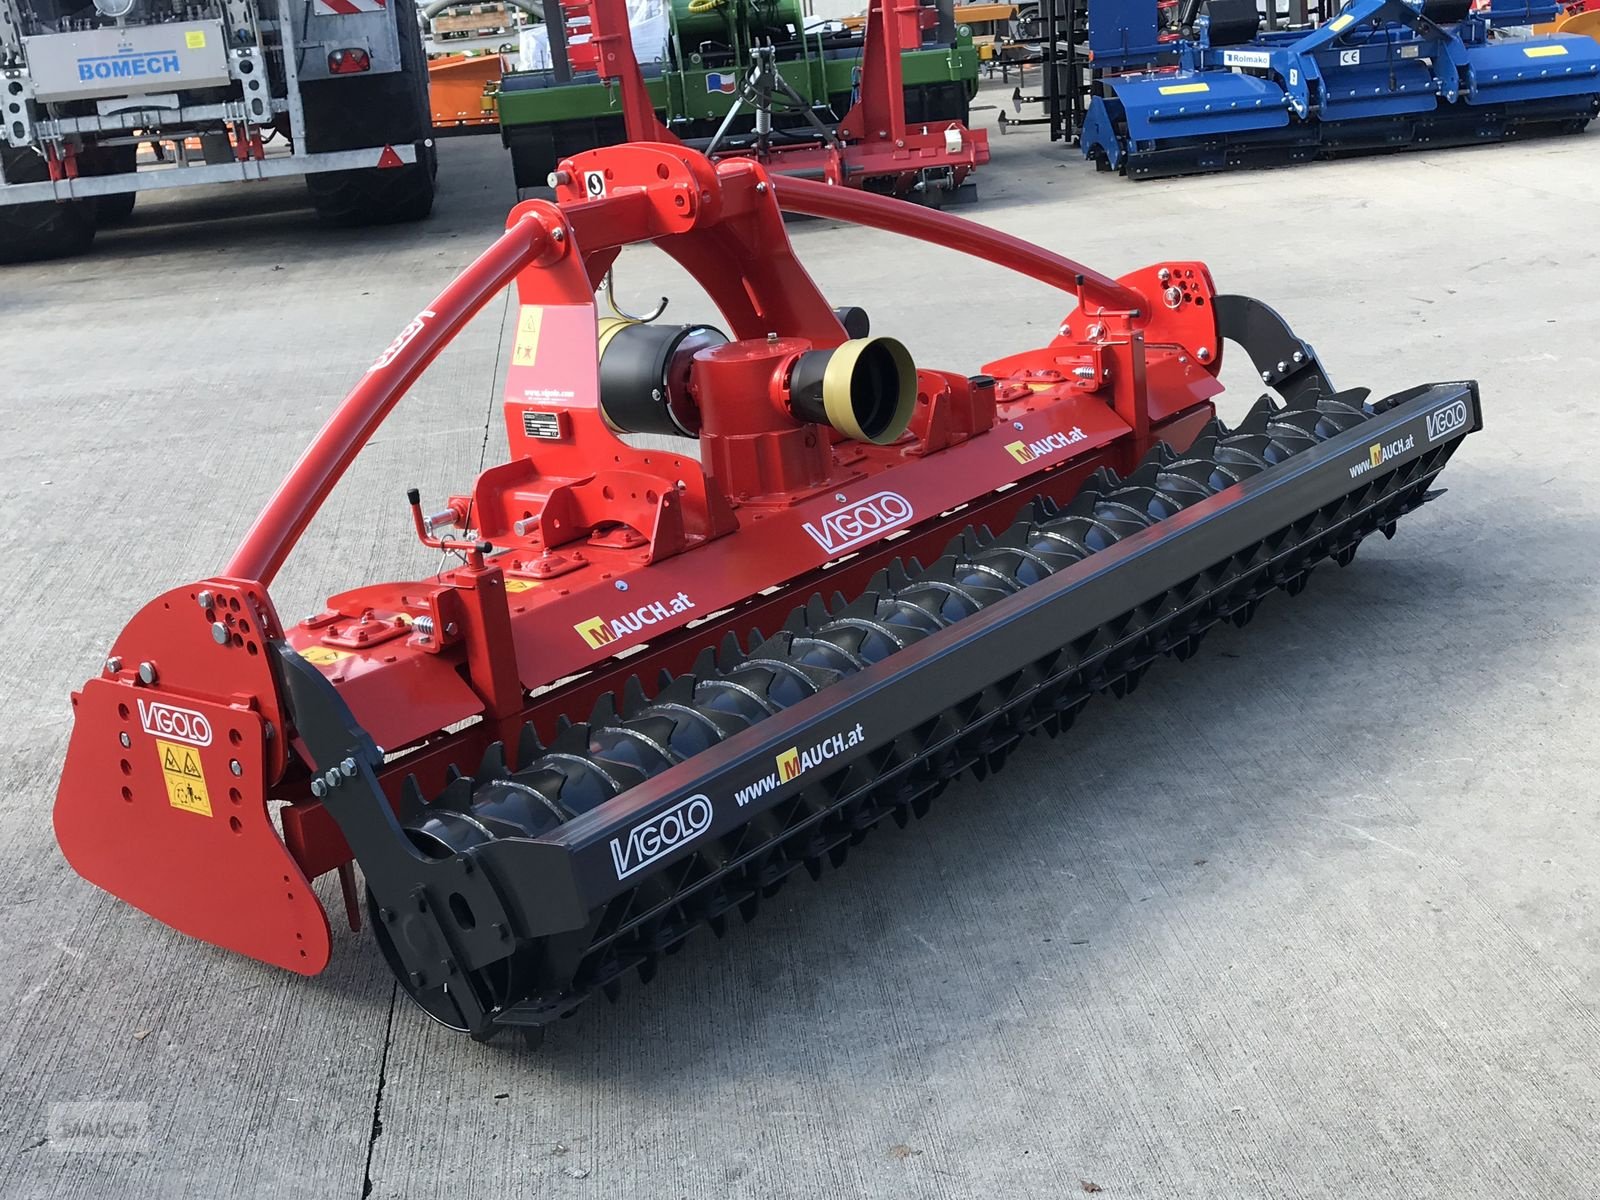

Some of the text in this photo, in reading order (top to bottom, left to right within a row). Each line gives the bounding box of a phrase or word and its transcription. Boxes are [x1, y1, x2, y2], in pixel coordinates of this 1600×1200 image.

[78, 56, 179, 80] BOMECH
[1233, 54, 1268, 64] Rolmako
[1342, 51, 1358, 63] CE
[1426, 400, 1467, 441] VIGOLO
[1013, 426, 1088, 462] MAUCH.at
[1349, 434, 1415, 478] www.MAUCH.at
[802, 491, 914, 554] VIGOLO
[587, 592, 696, 646] MAUCH.at
[137, 698, 213, 747] VIGOLO
[734, 723, 865, 807] www.MAUCH.at
[610, 794, 713, 880] VIGOLO
